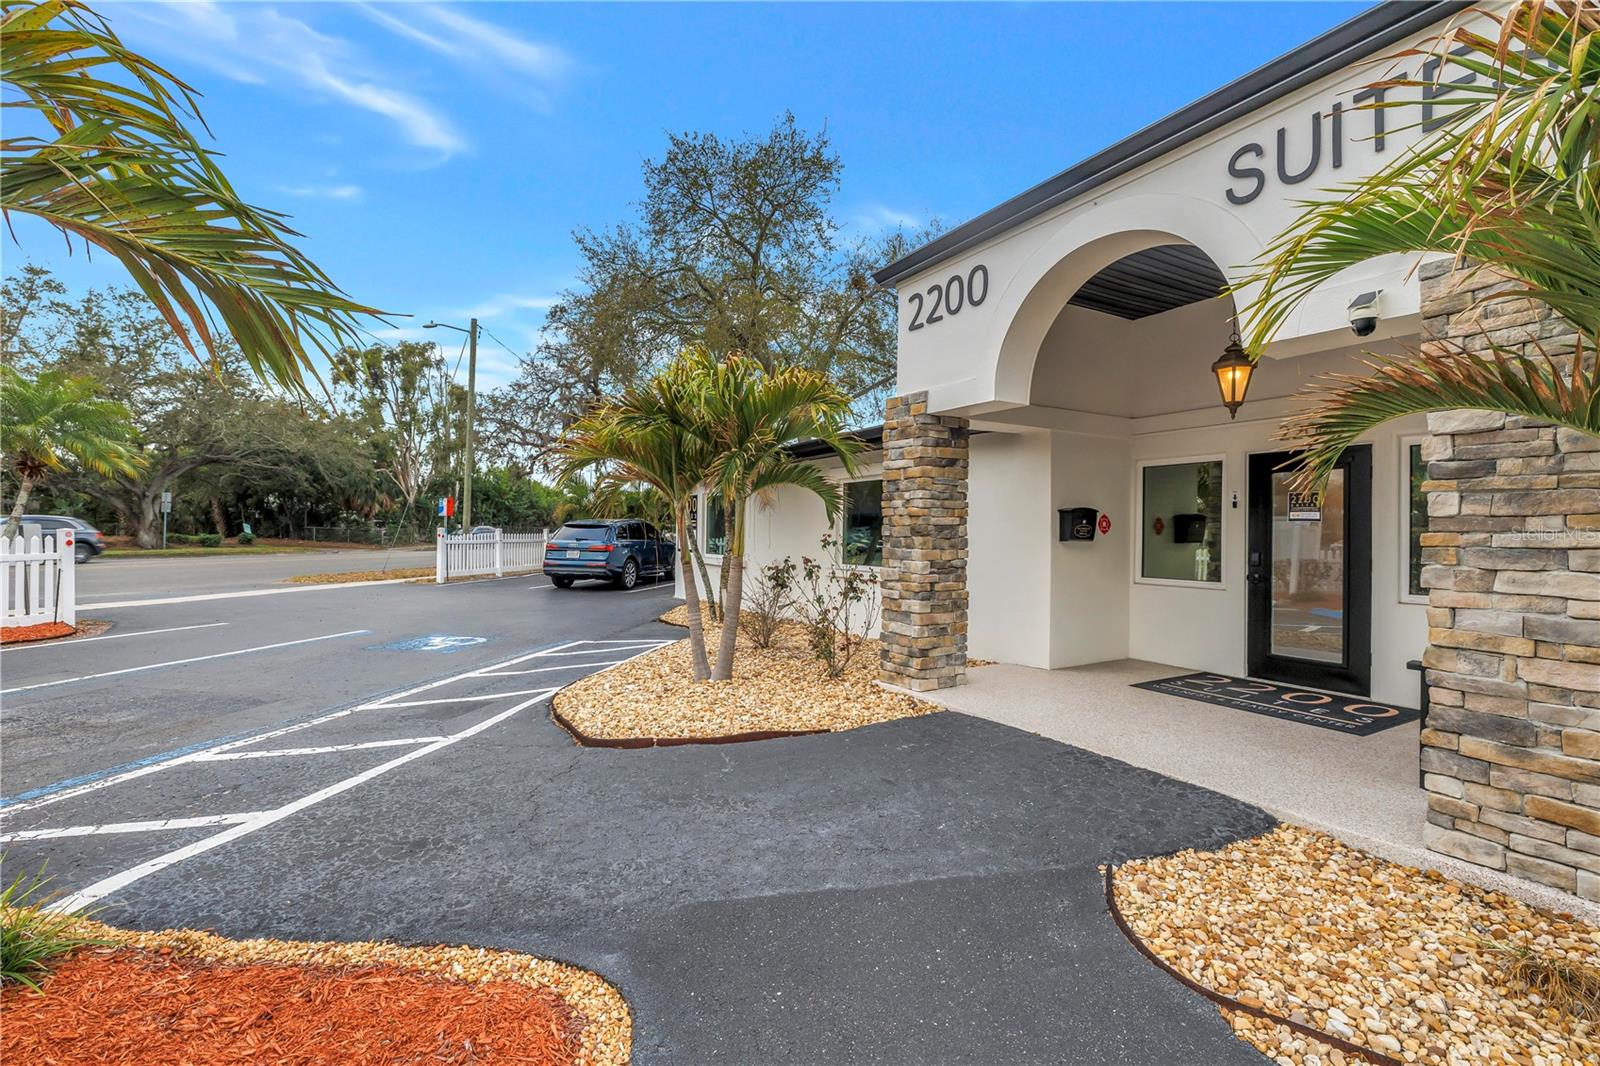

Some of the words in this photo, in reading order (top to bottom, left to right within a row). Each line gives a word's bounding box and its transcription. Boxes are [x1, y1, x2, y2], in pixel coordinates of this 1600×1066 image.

[908, 264, 989, 331] 2200
[1170, 681, 1374, 723] SUITES
[1184, 675, 1399, 718] 2200
[1292, 713, 1357, 729] CENTER
